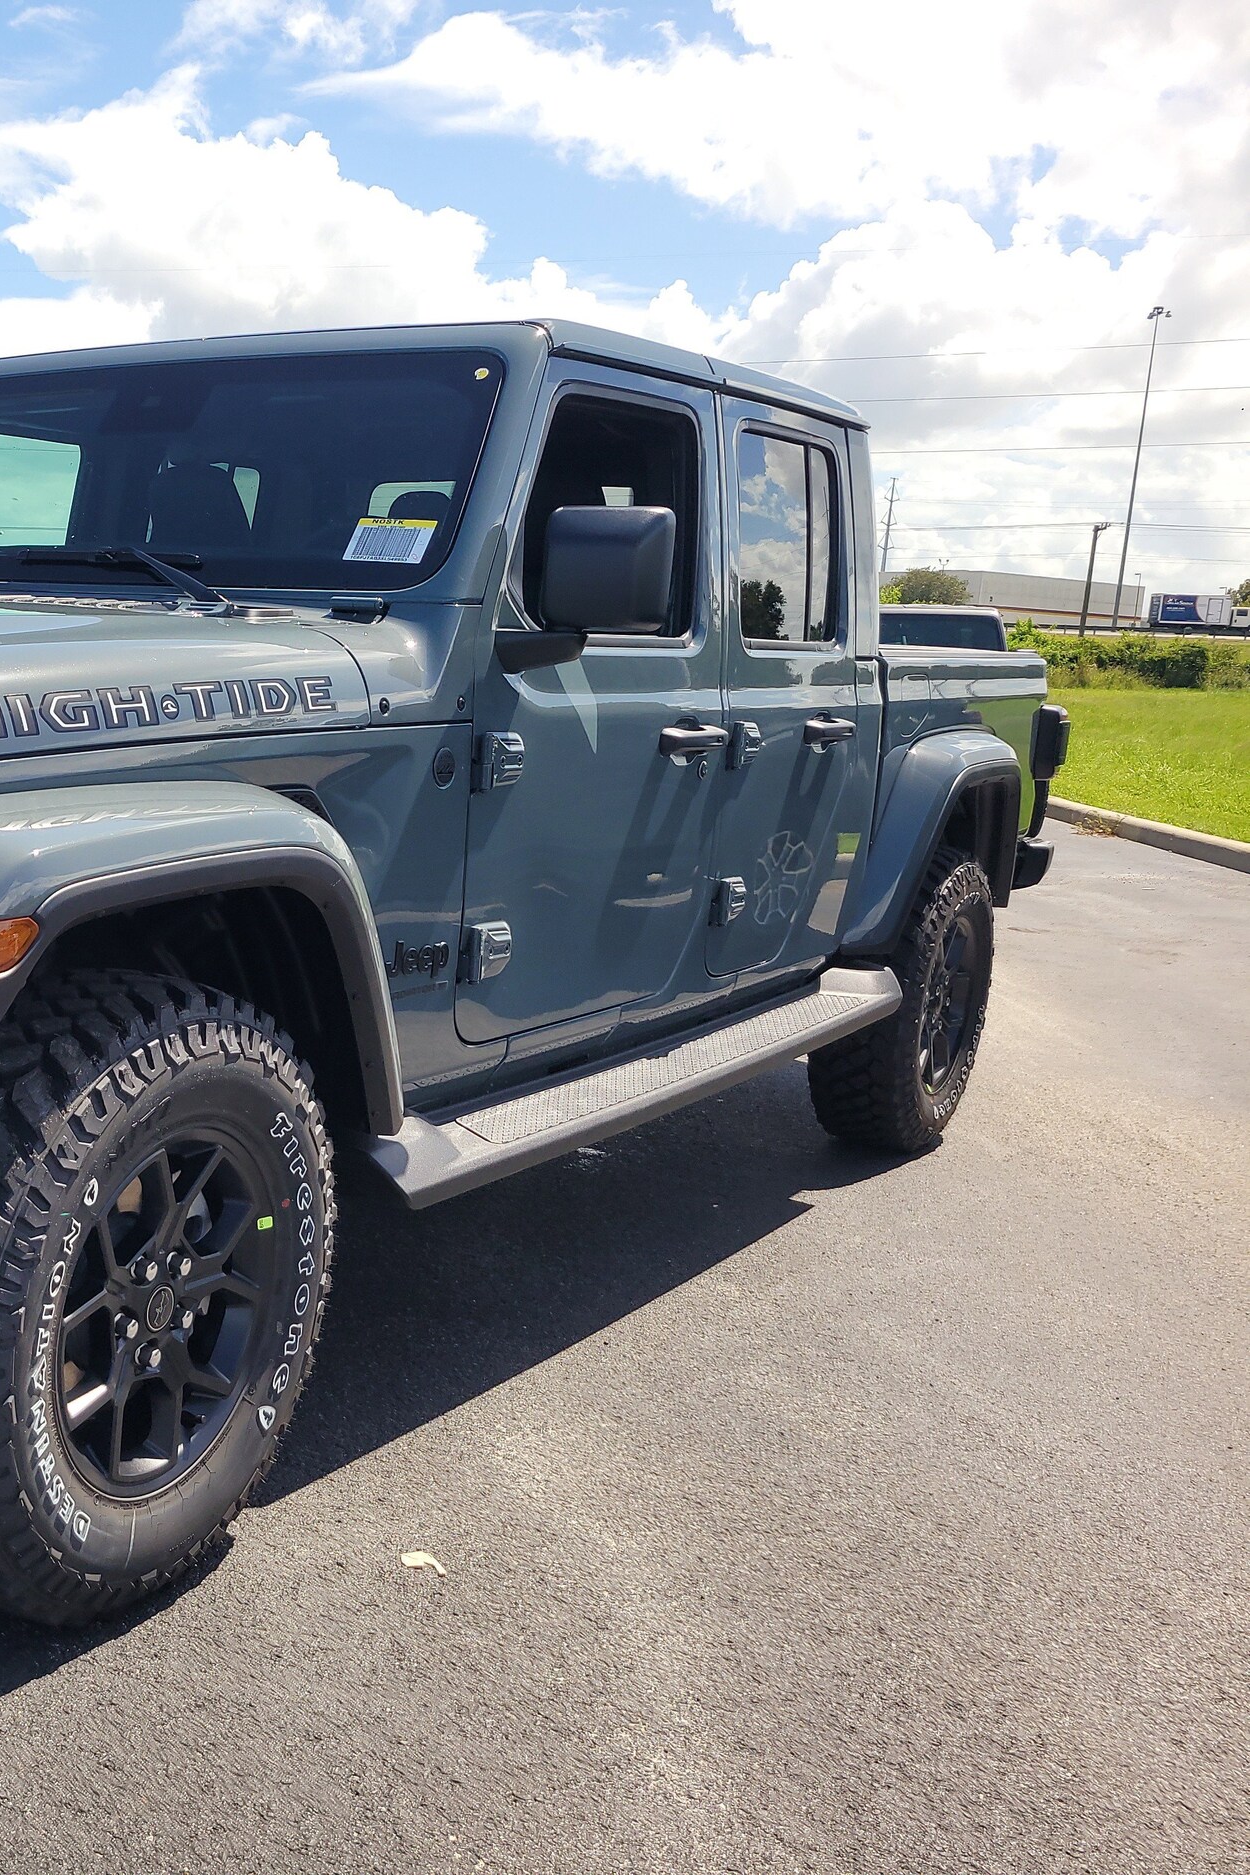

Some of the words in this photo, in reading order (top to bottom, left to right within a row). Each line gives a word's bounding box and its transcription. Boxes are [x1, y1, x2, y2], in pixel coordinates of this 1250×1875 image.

[173, 675, 338, 723] TIDE
[385, 940, 450, 978] Jeep
[270, 1112, 317, 1394] Firestone
[30, 1217, 91, 1543] DESTINATION
